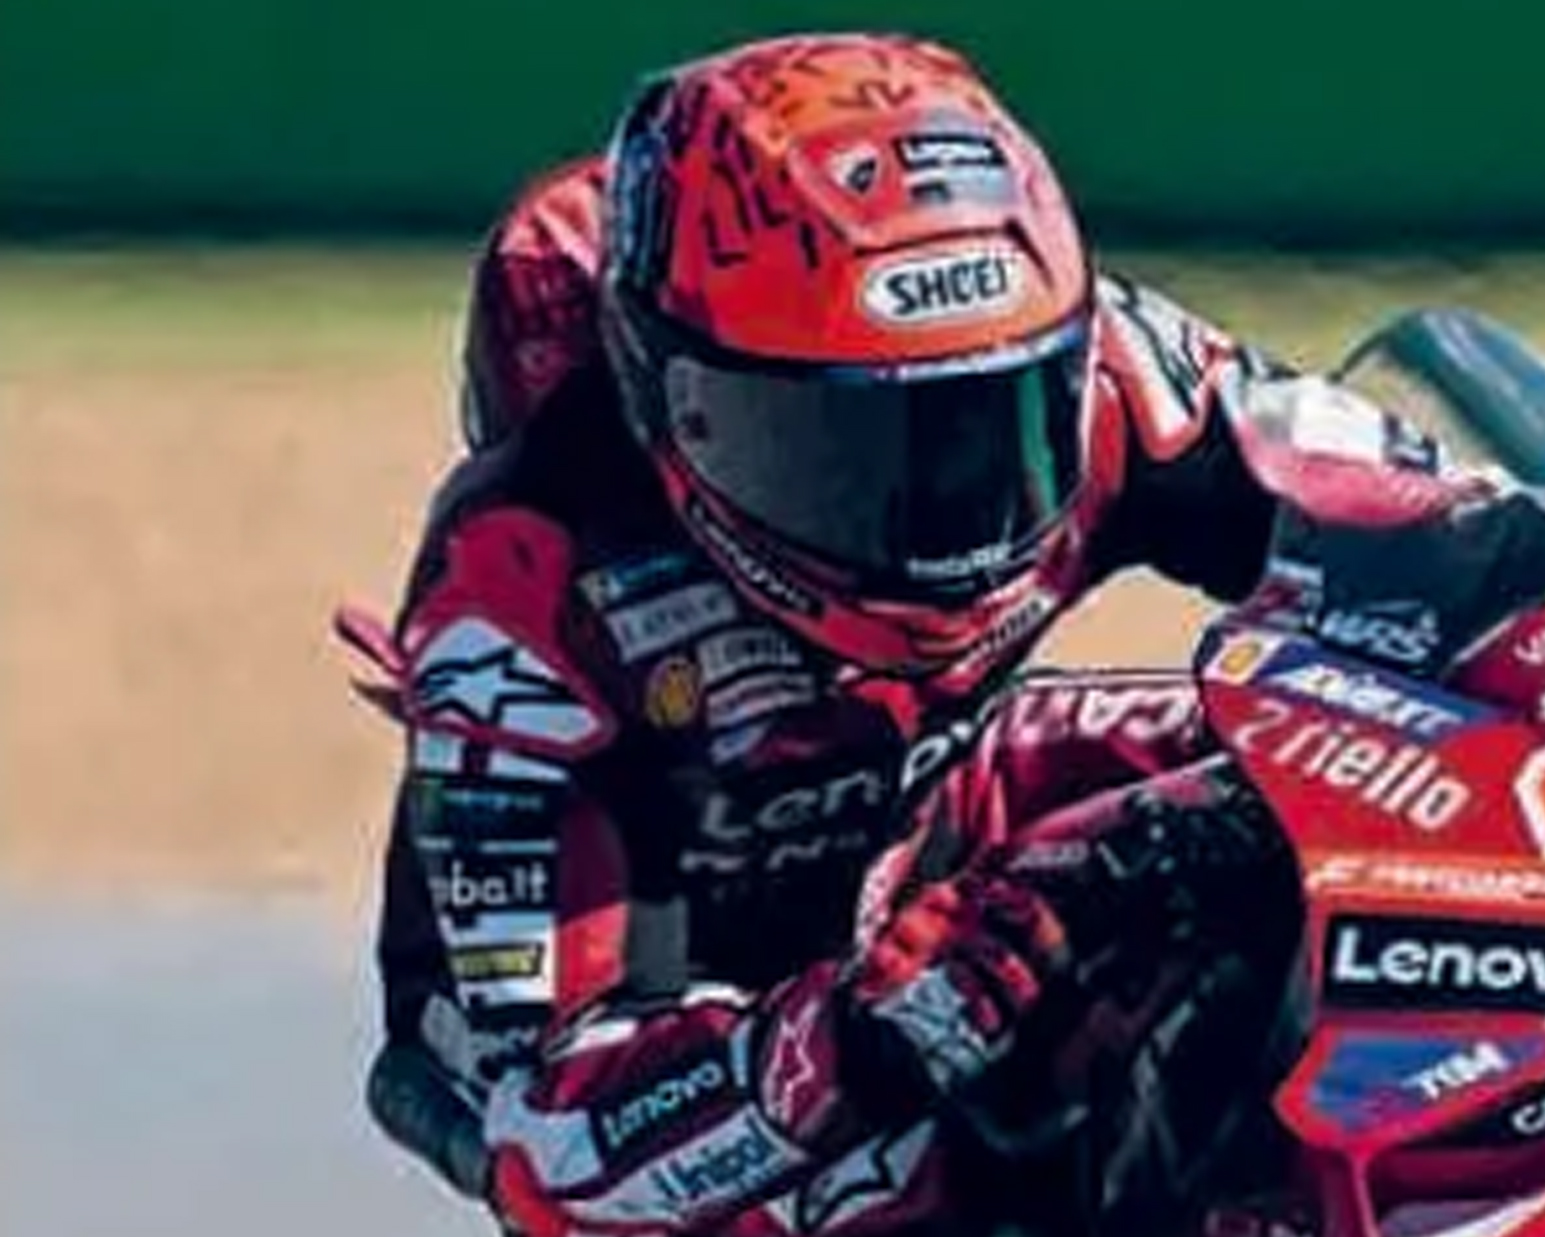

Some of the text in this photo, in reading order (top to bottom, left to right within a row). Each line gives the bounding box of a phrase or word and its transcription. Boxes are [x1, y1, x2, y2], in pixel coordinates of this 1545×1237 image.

[1272, 714, 1470, 832] riello
[602, 1060, 724, 1148] Lenovo
[1402, 1039, 1509, 1102] TIM
